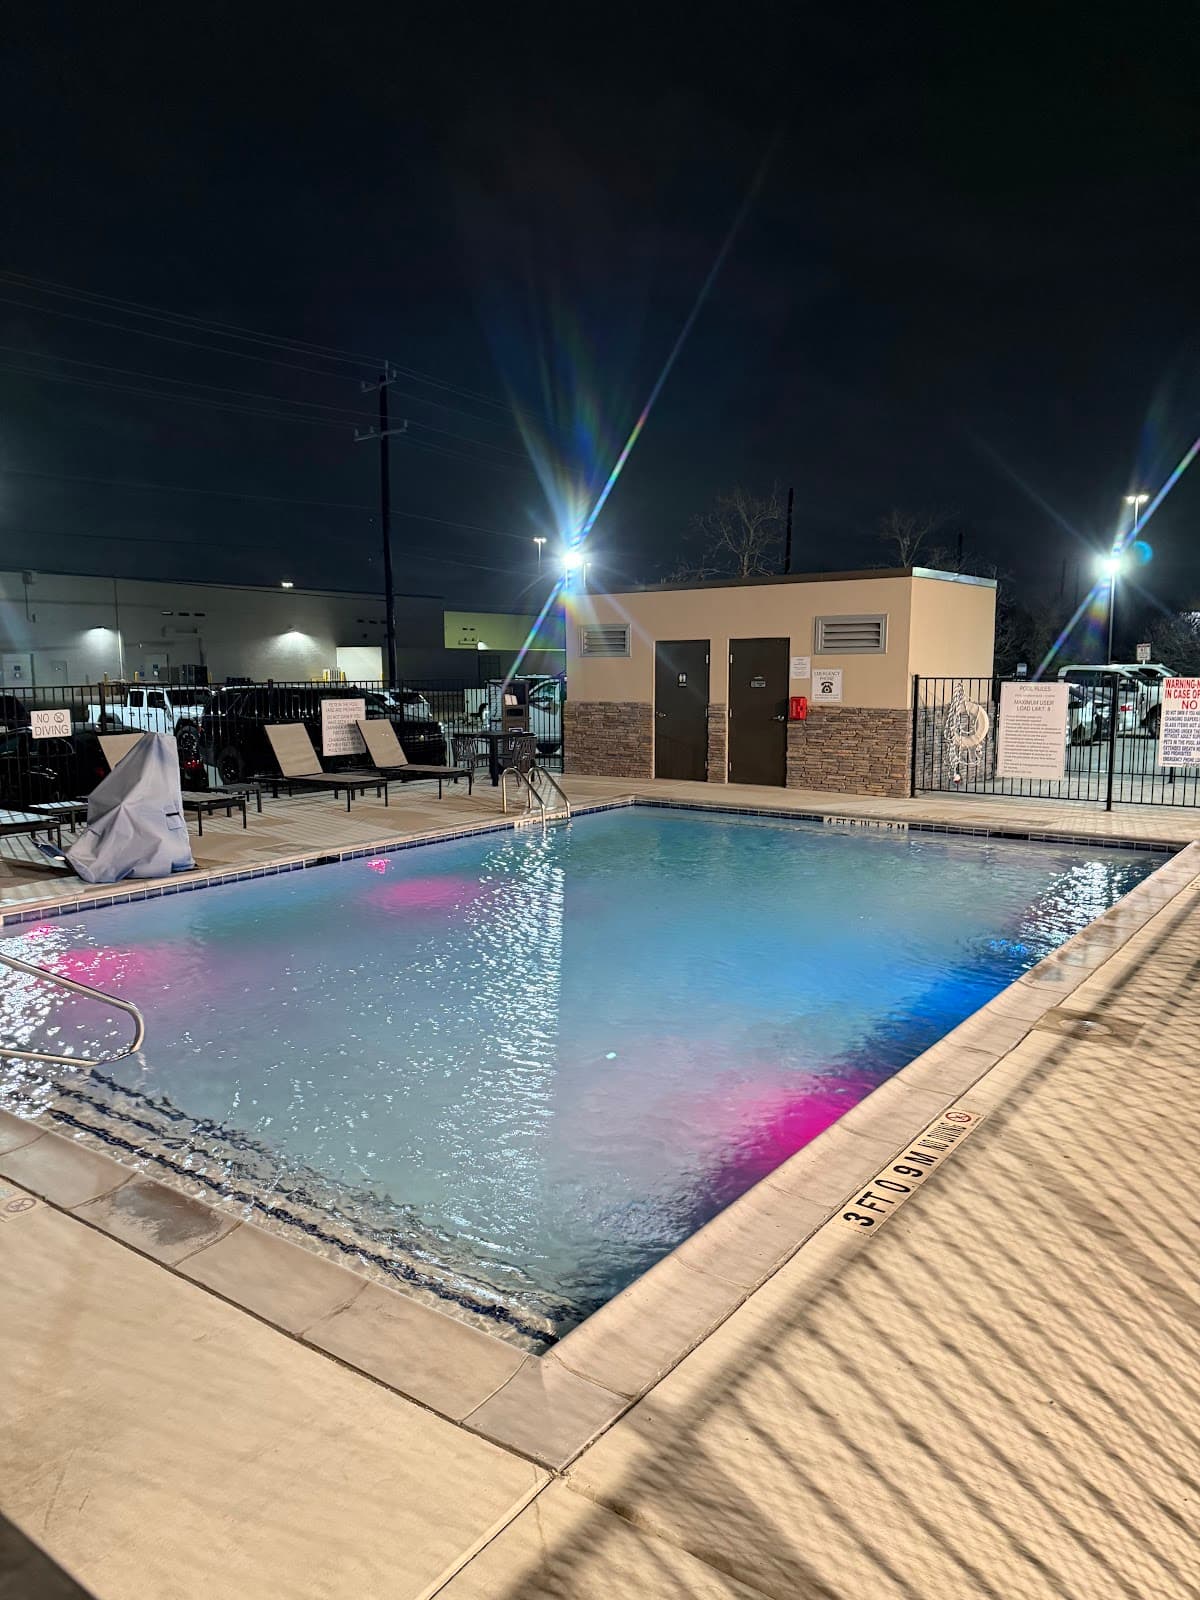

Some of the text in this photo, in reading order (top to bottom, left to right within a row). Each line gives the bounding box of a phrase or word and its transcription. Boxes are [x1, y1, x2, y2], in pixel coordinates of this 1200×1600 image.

[1165, 690, 1171, 699] IN
[1173, 690, 1190, 699] CASE
[1181, 700, 1197, 710] NO
[36, 713, 49, 723] NO
[35, 725, 69, 736] DIVING
[926, 1122, 967, 1143] DIVING
[917, 1139, 950, 1152] NO
[903, 1150, 939, 1166] M
[854, 1191, 895, 1213] FT
[843, 1212, 875, 1227] 3
